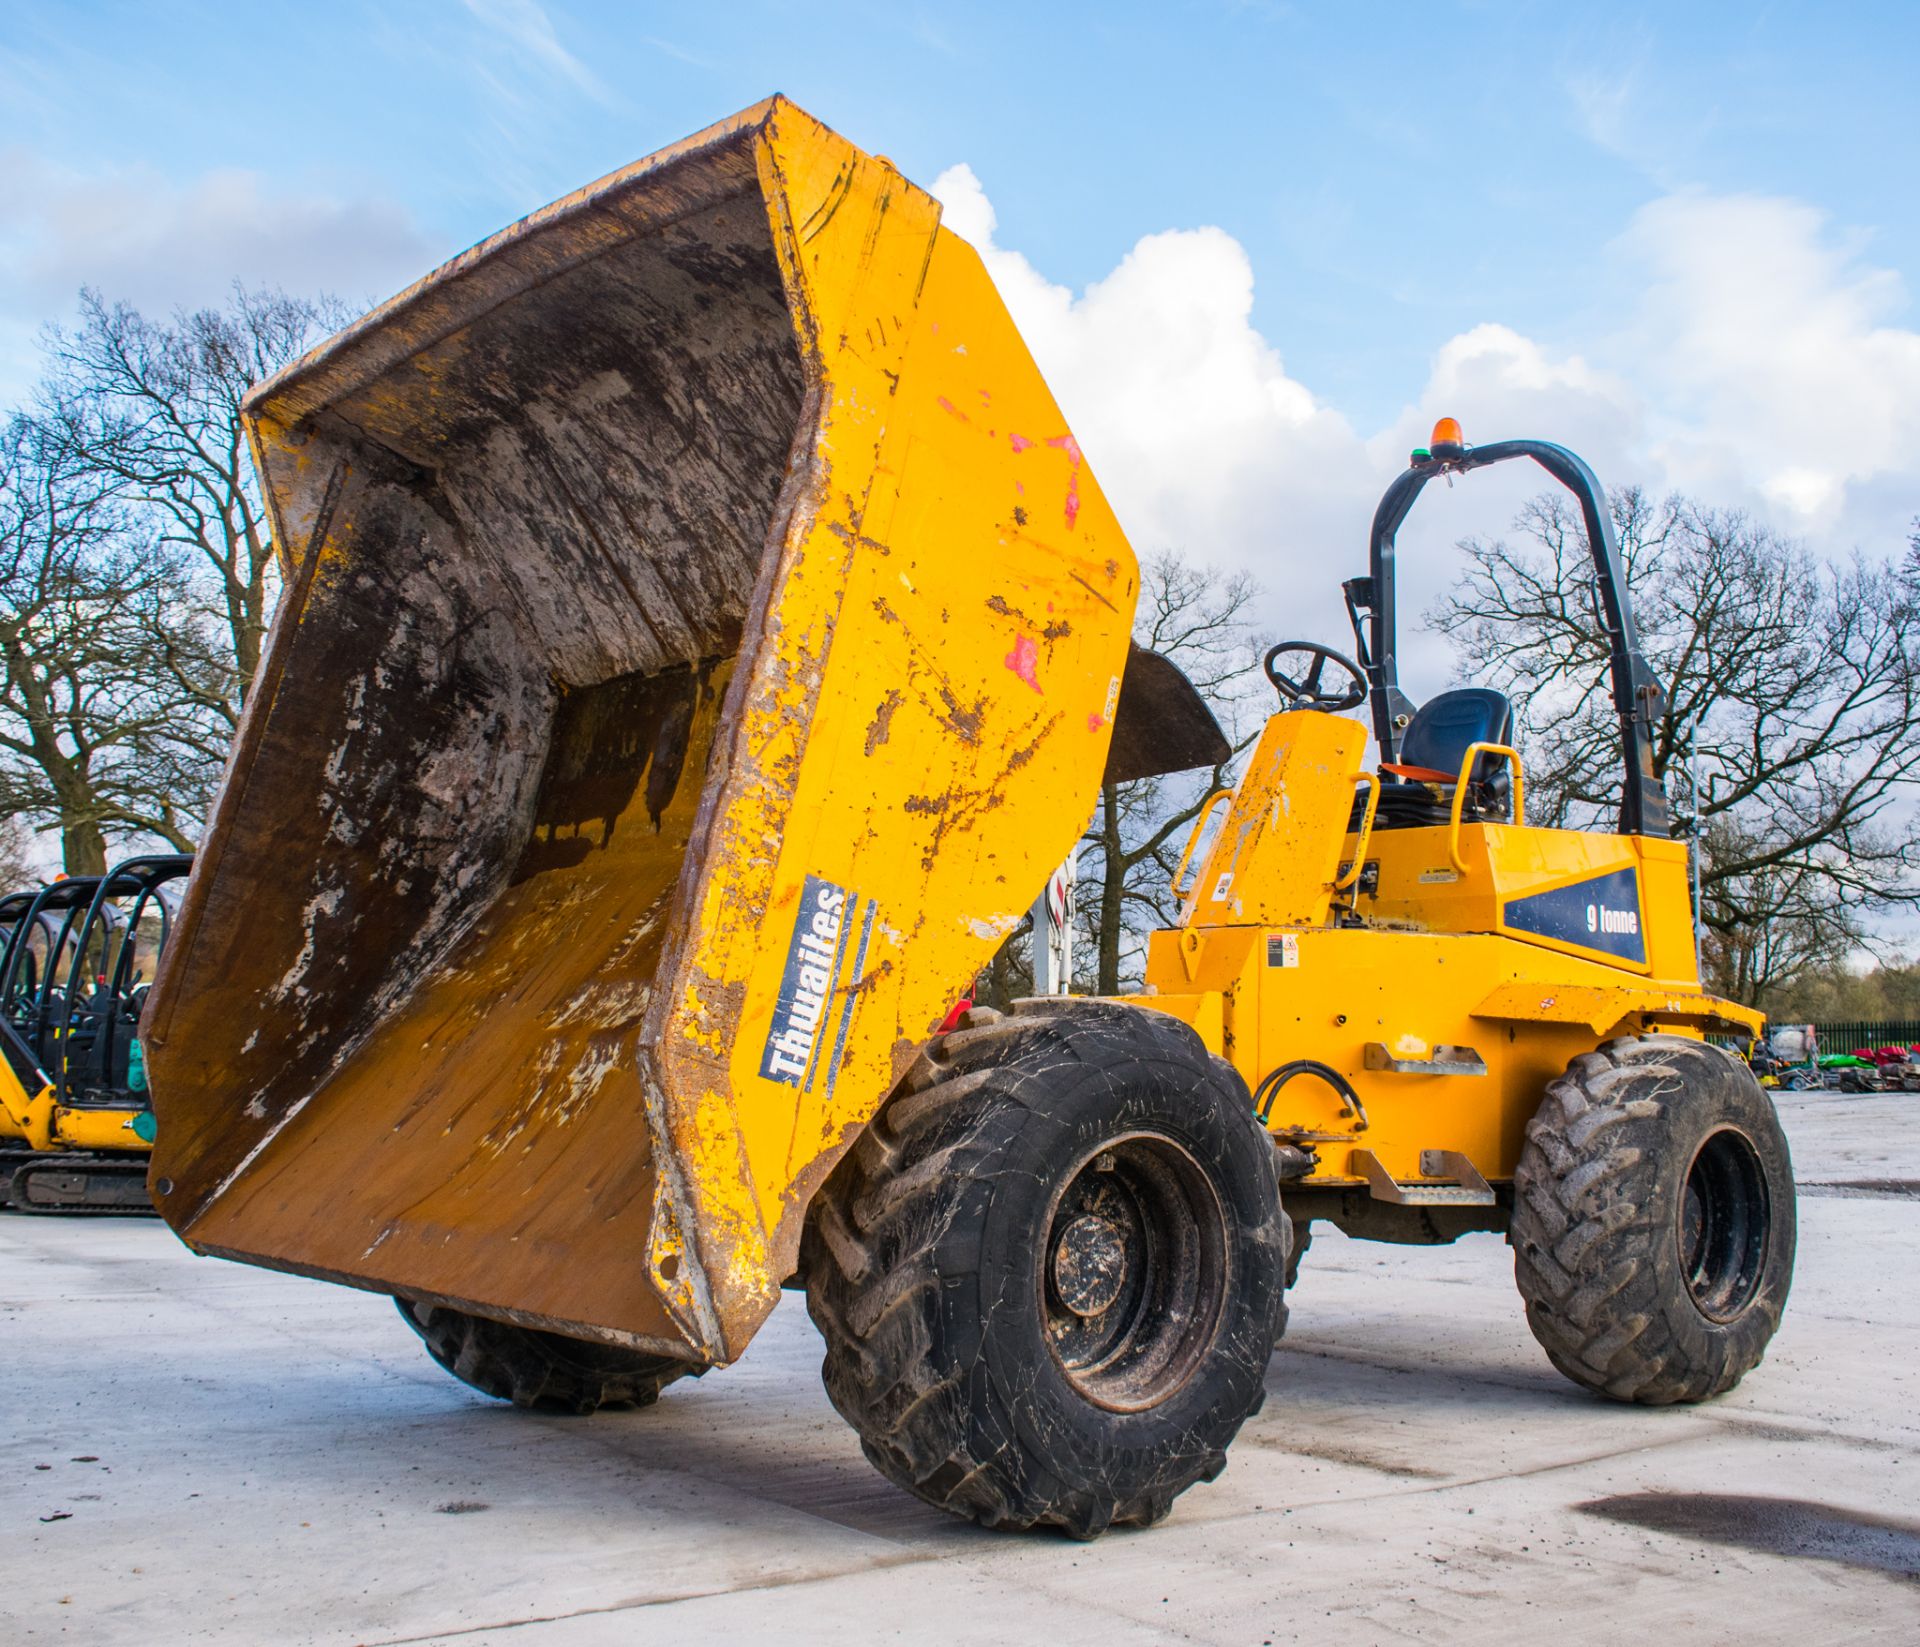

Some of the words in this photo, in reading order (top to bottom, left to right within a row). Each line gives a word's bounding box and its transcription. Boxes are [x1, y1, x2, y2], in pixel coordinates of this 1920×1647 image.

[1587, 905, 1597, 932] 9
[1601, 905, 1637, 934] tonne
[769, 888, 844, 1077] Thwaites
